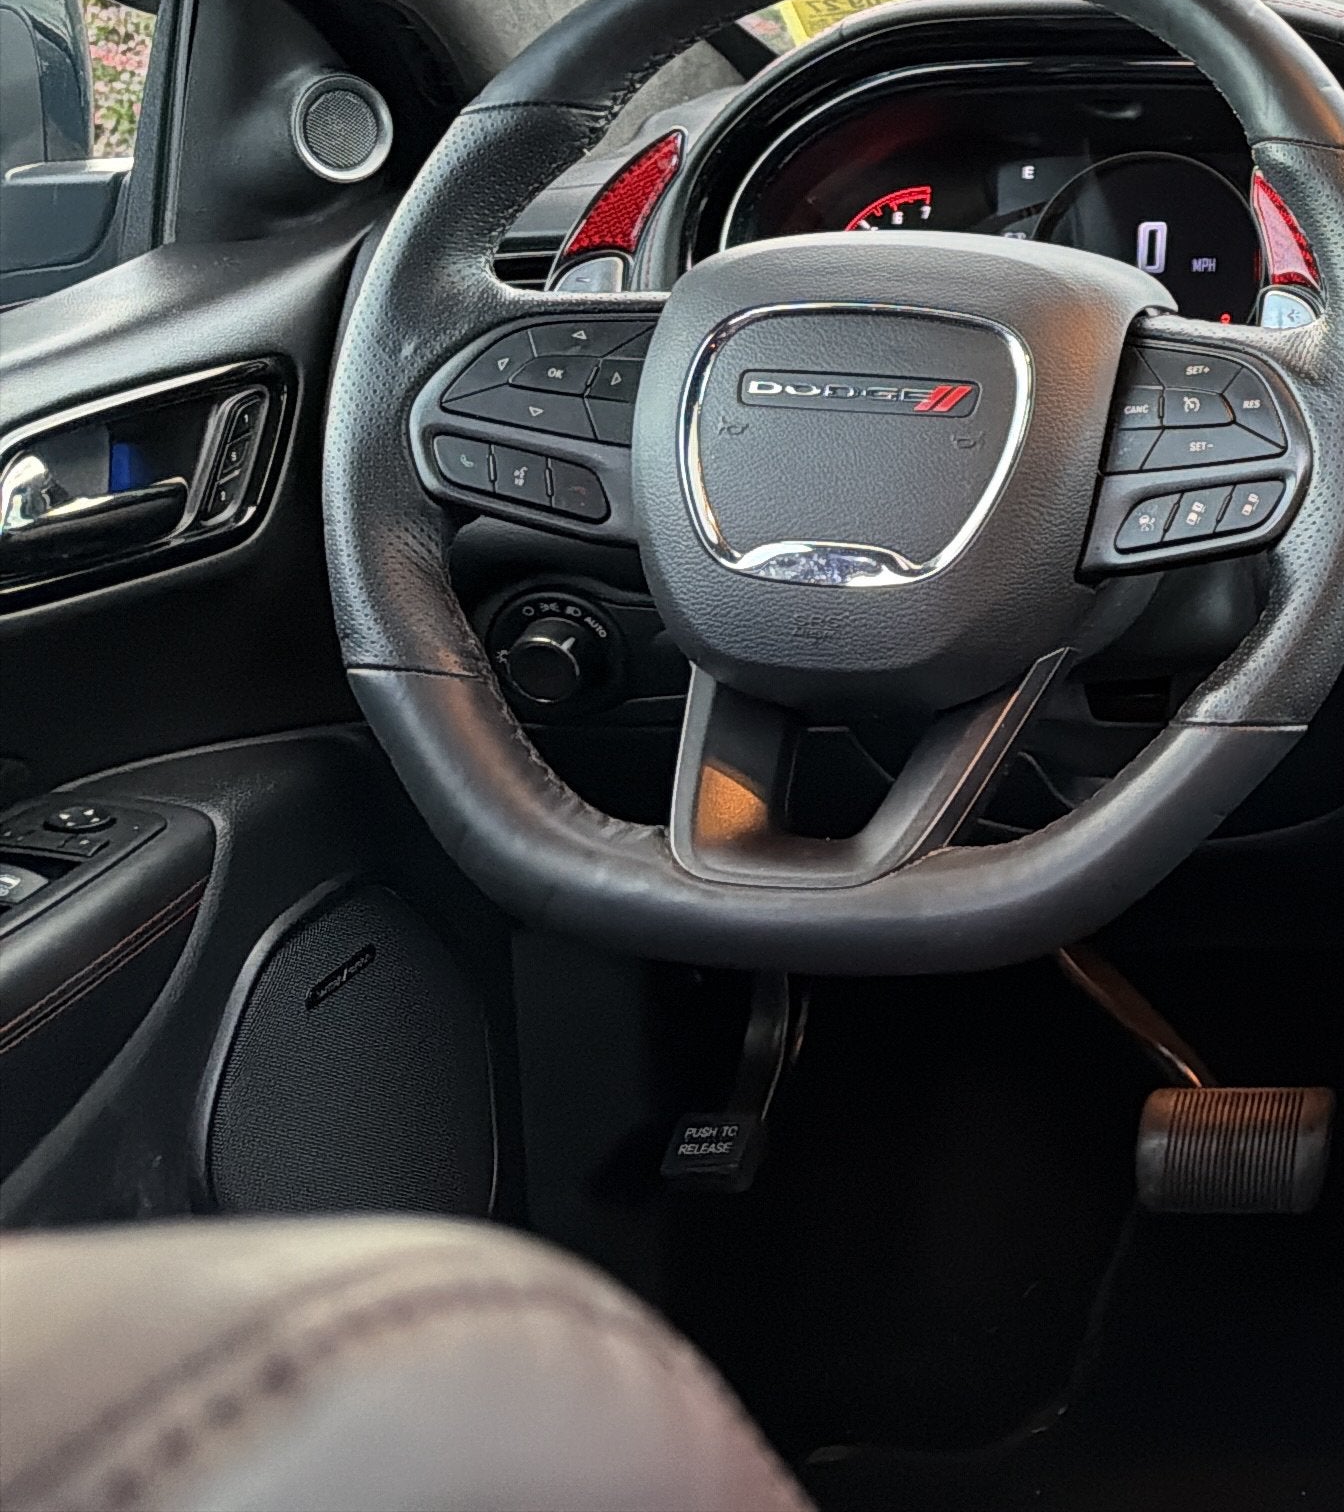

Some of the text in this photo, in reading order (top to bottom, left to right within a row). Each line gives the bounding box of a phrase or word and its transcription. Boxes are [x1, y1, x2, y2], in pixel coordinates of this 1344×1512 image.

[1021, 165, 1035, 180] E
[1136, 220, 1168, 274] 0
[1191, 257, 1217, 273] MPH
[547, 368, 564, 379] OK
[747, 380, 930, 403] DODGE
[1124, 404, 1150, 415] CANC
[1242, 399, 1261, 409] RES
[584, 616, 608, 638] AUTO
[684, 1125, 739, 1143] PUSH TO
[677, 1141, 733, 1156] RELEASE
